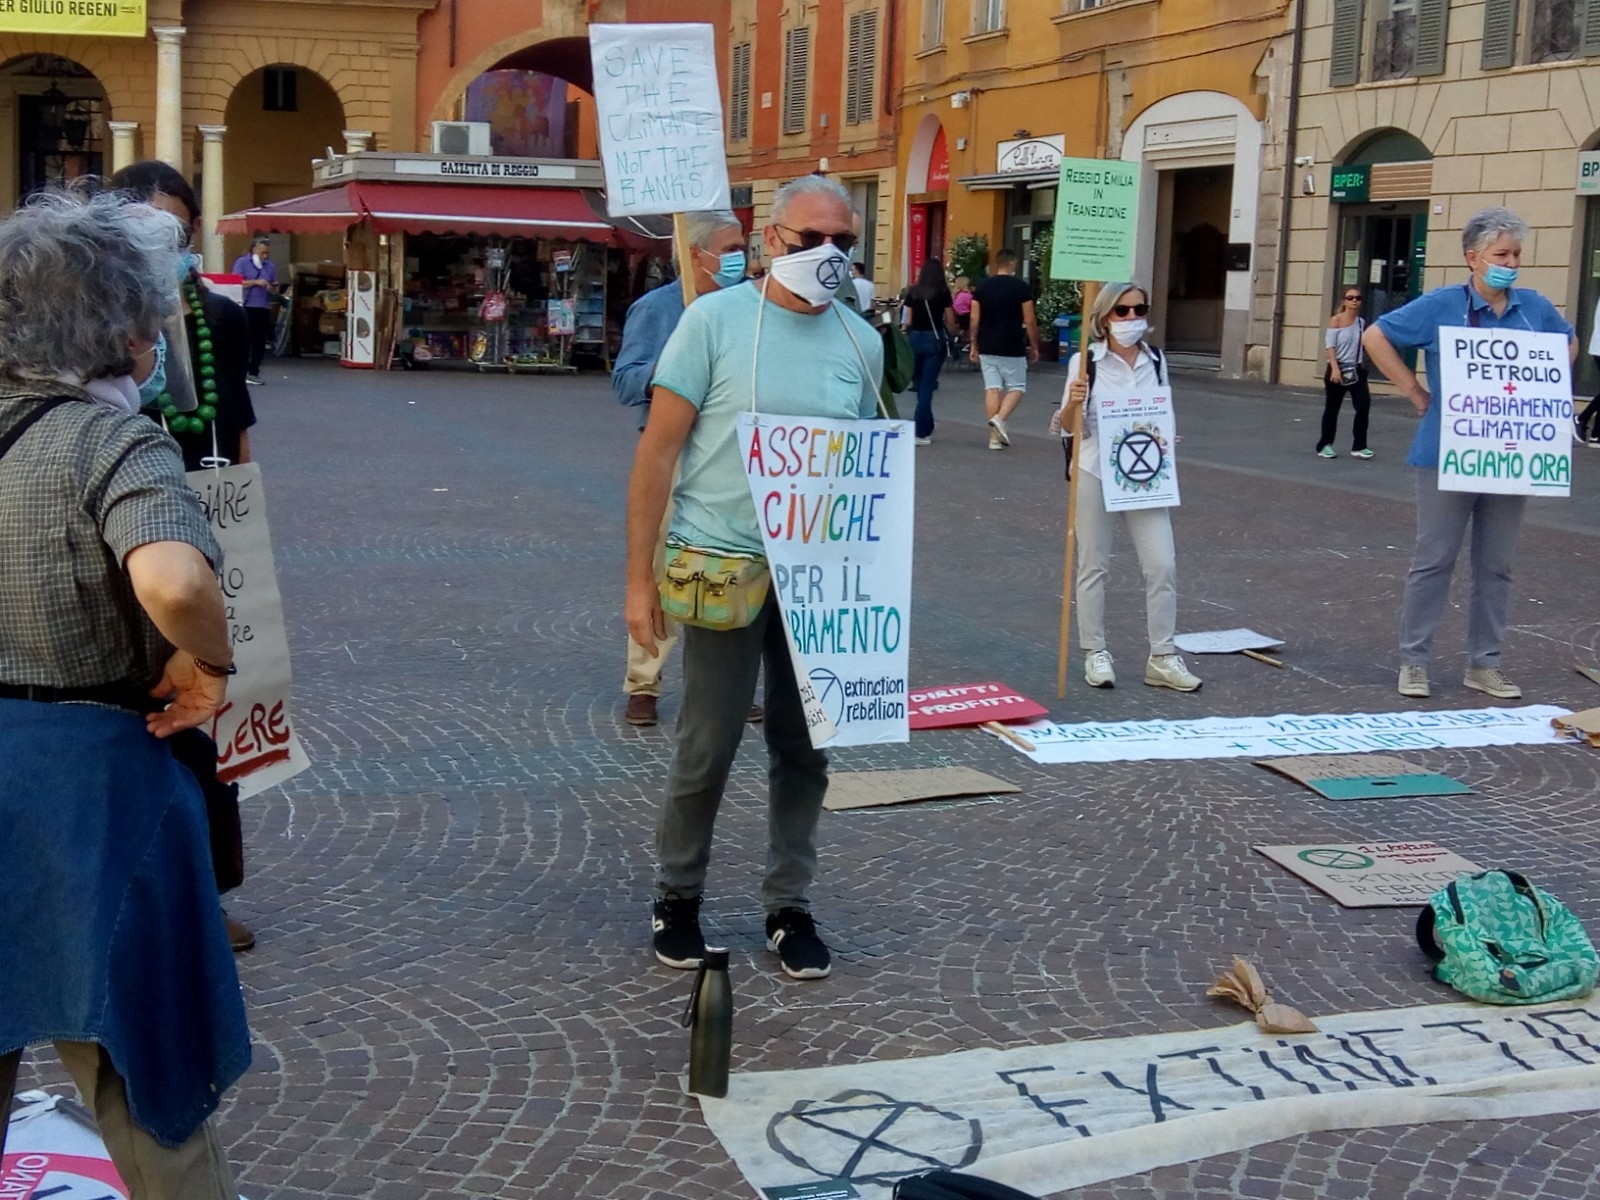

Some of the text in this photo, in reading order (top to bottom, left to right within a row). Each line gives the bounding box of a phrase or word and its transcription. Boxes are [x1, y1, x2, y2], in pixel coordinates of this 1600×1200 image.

[20, 0, 63, 14] GIULIO
[68, 1, 117, 16] REGENI
[605, 47, 692, 77] SAVE
[616, 82, 690, 107] THE
[441, 161, 539, 177] GAZZETTA DI REGGIO
[657, 145, 709, 173] THE
[621, 172, 704, 206] BANKS
[1093, 188, 1104, 200] IN
[1455, 339, 1555, 361] PICCO DEL
[1467, 362, 1562, 384] PETROLIO
[1449, 393, 1573, 419] CAMBIAMENTO
[1453, 418, 1556, 441] CLIMATICO
[748, 425, 900, 478] ASSEMBLEE
[1443, 449, 1570, 483] AGIAMO ORA
[775, 563, 824, 604] PER
[844, 676, 905, 698] extinction
[909, 684, 999, 703] DIRITTI
[846, 697, 905, 723] rebellion
[919, 695, 1025, 715] PROFITTI
[1267, 731, 1446, 752] FUTURO
